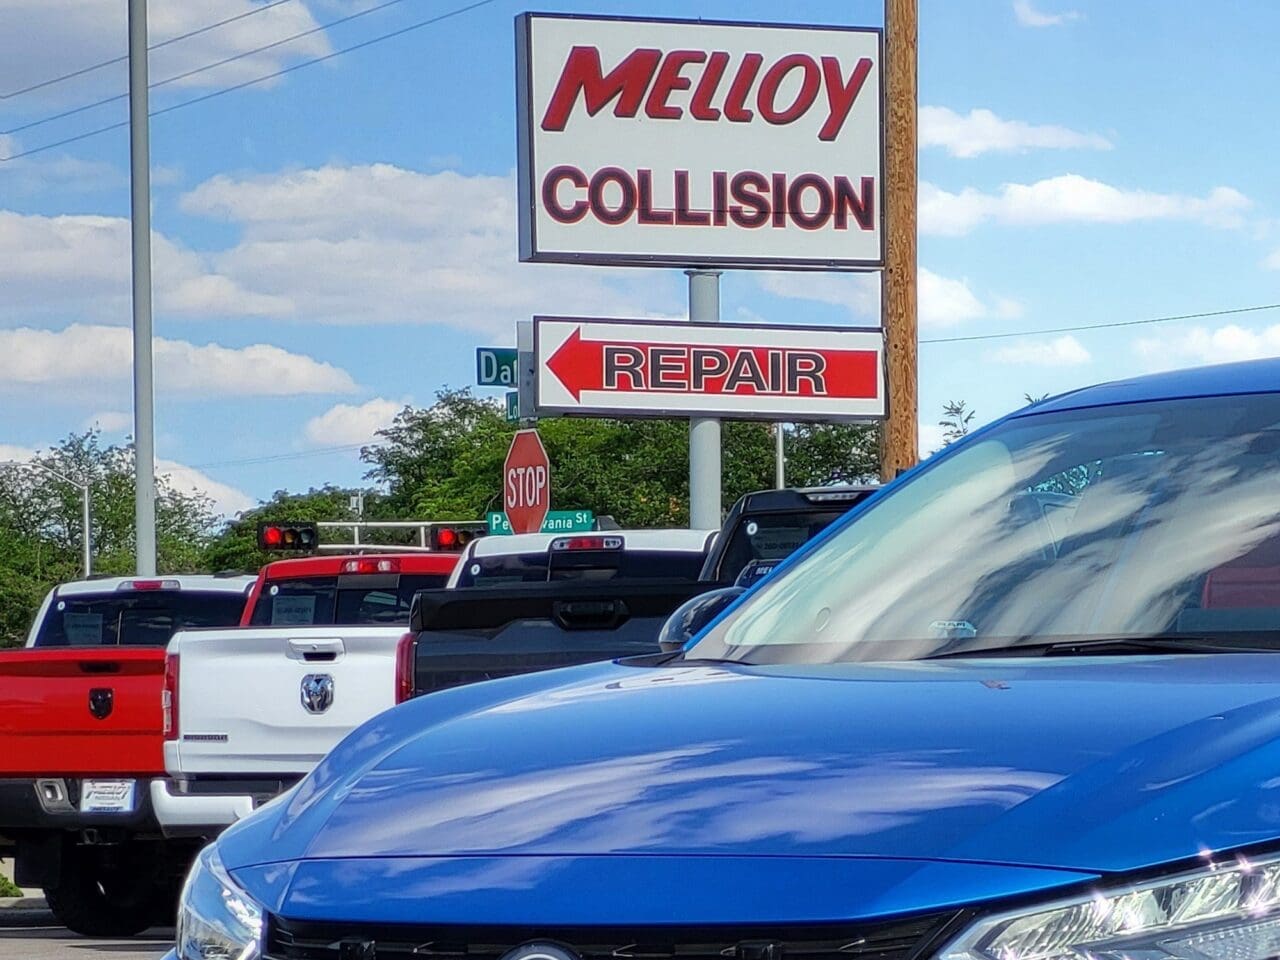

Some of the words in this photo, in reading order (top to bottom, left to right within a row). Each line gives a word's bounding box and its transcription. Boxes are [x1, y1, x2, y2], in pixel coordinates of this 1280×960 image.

[541, 46, 873, 141] MELLOY
[542, 165, 875, 230] COLLISION
[602, 345, 827, 395] REPAIR
[507, 466, 546, 508] STOP
[575, 512, 587, 523] St
